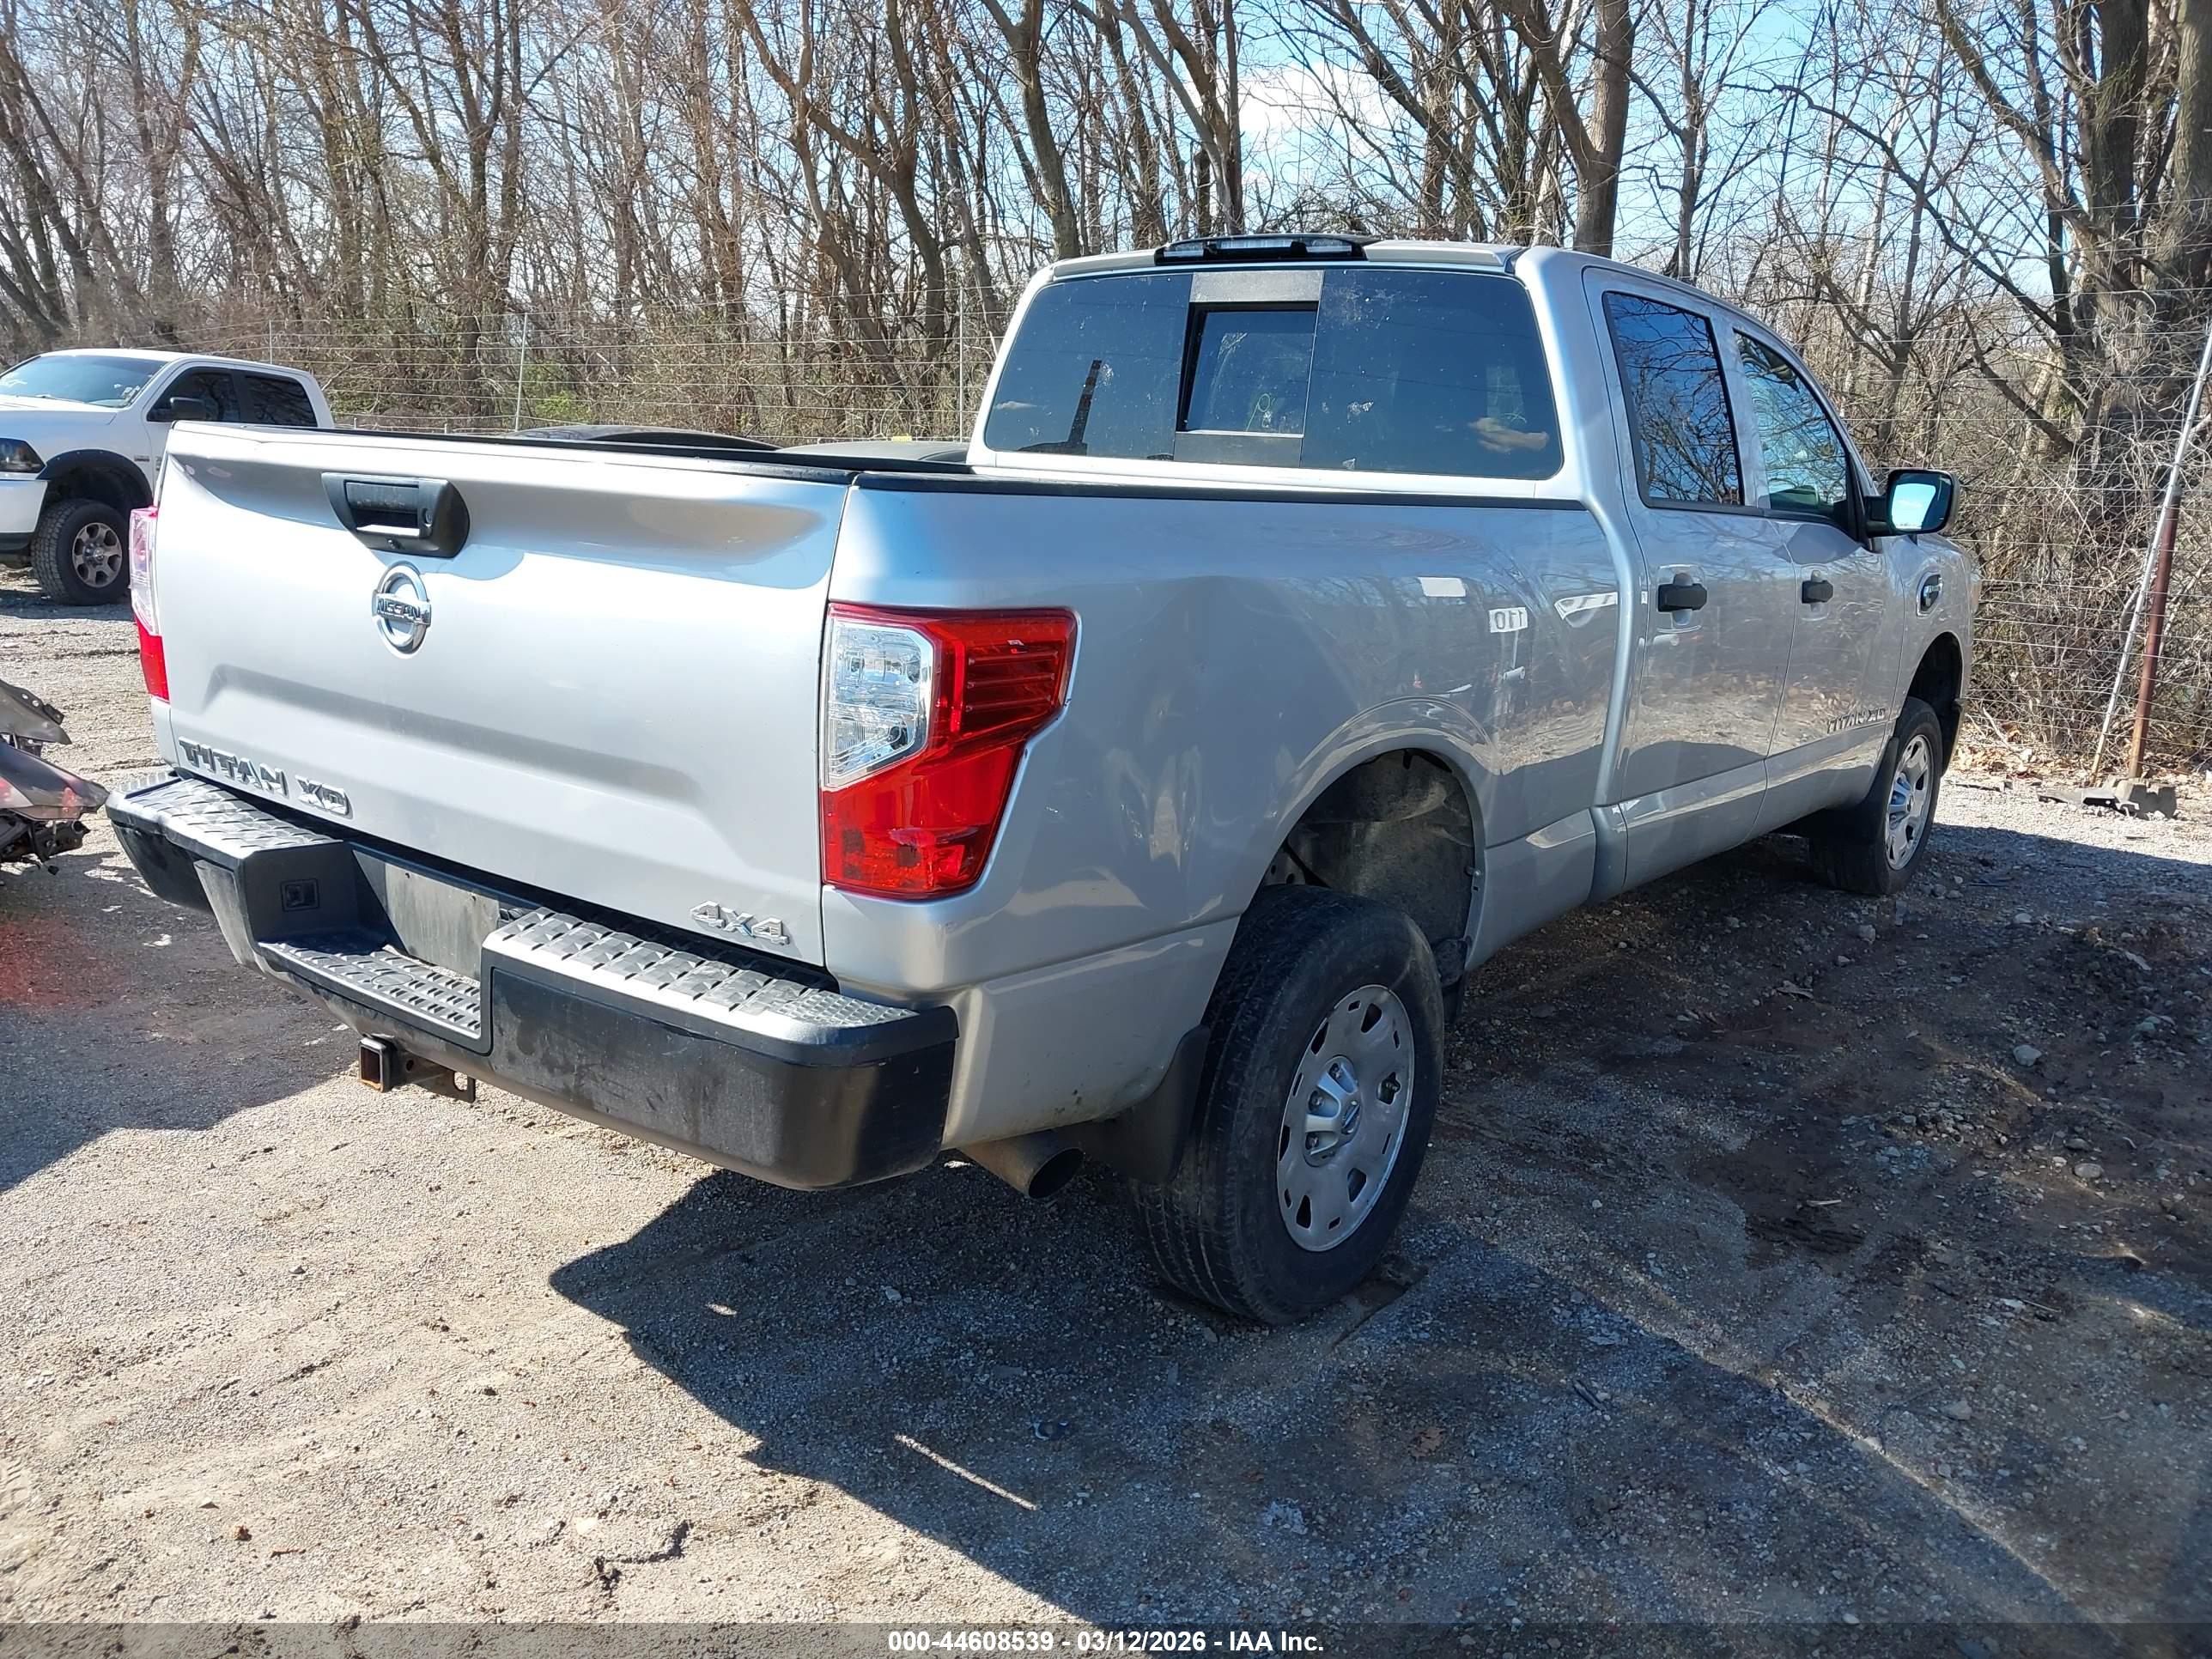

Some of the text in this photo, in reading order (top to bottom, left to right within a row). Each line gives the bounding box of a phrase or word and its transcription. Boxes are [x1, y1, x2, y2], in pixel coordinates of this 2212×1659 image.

[377, 599, 422, 623] NISSAN
[179, 736, 354, 819] TITAN XD
